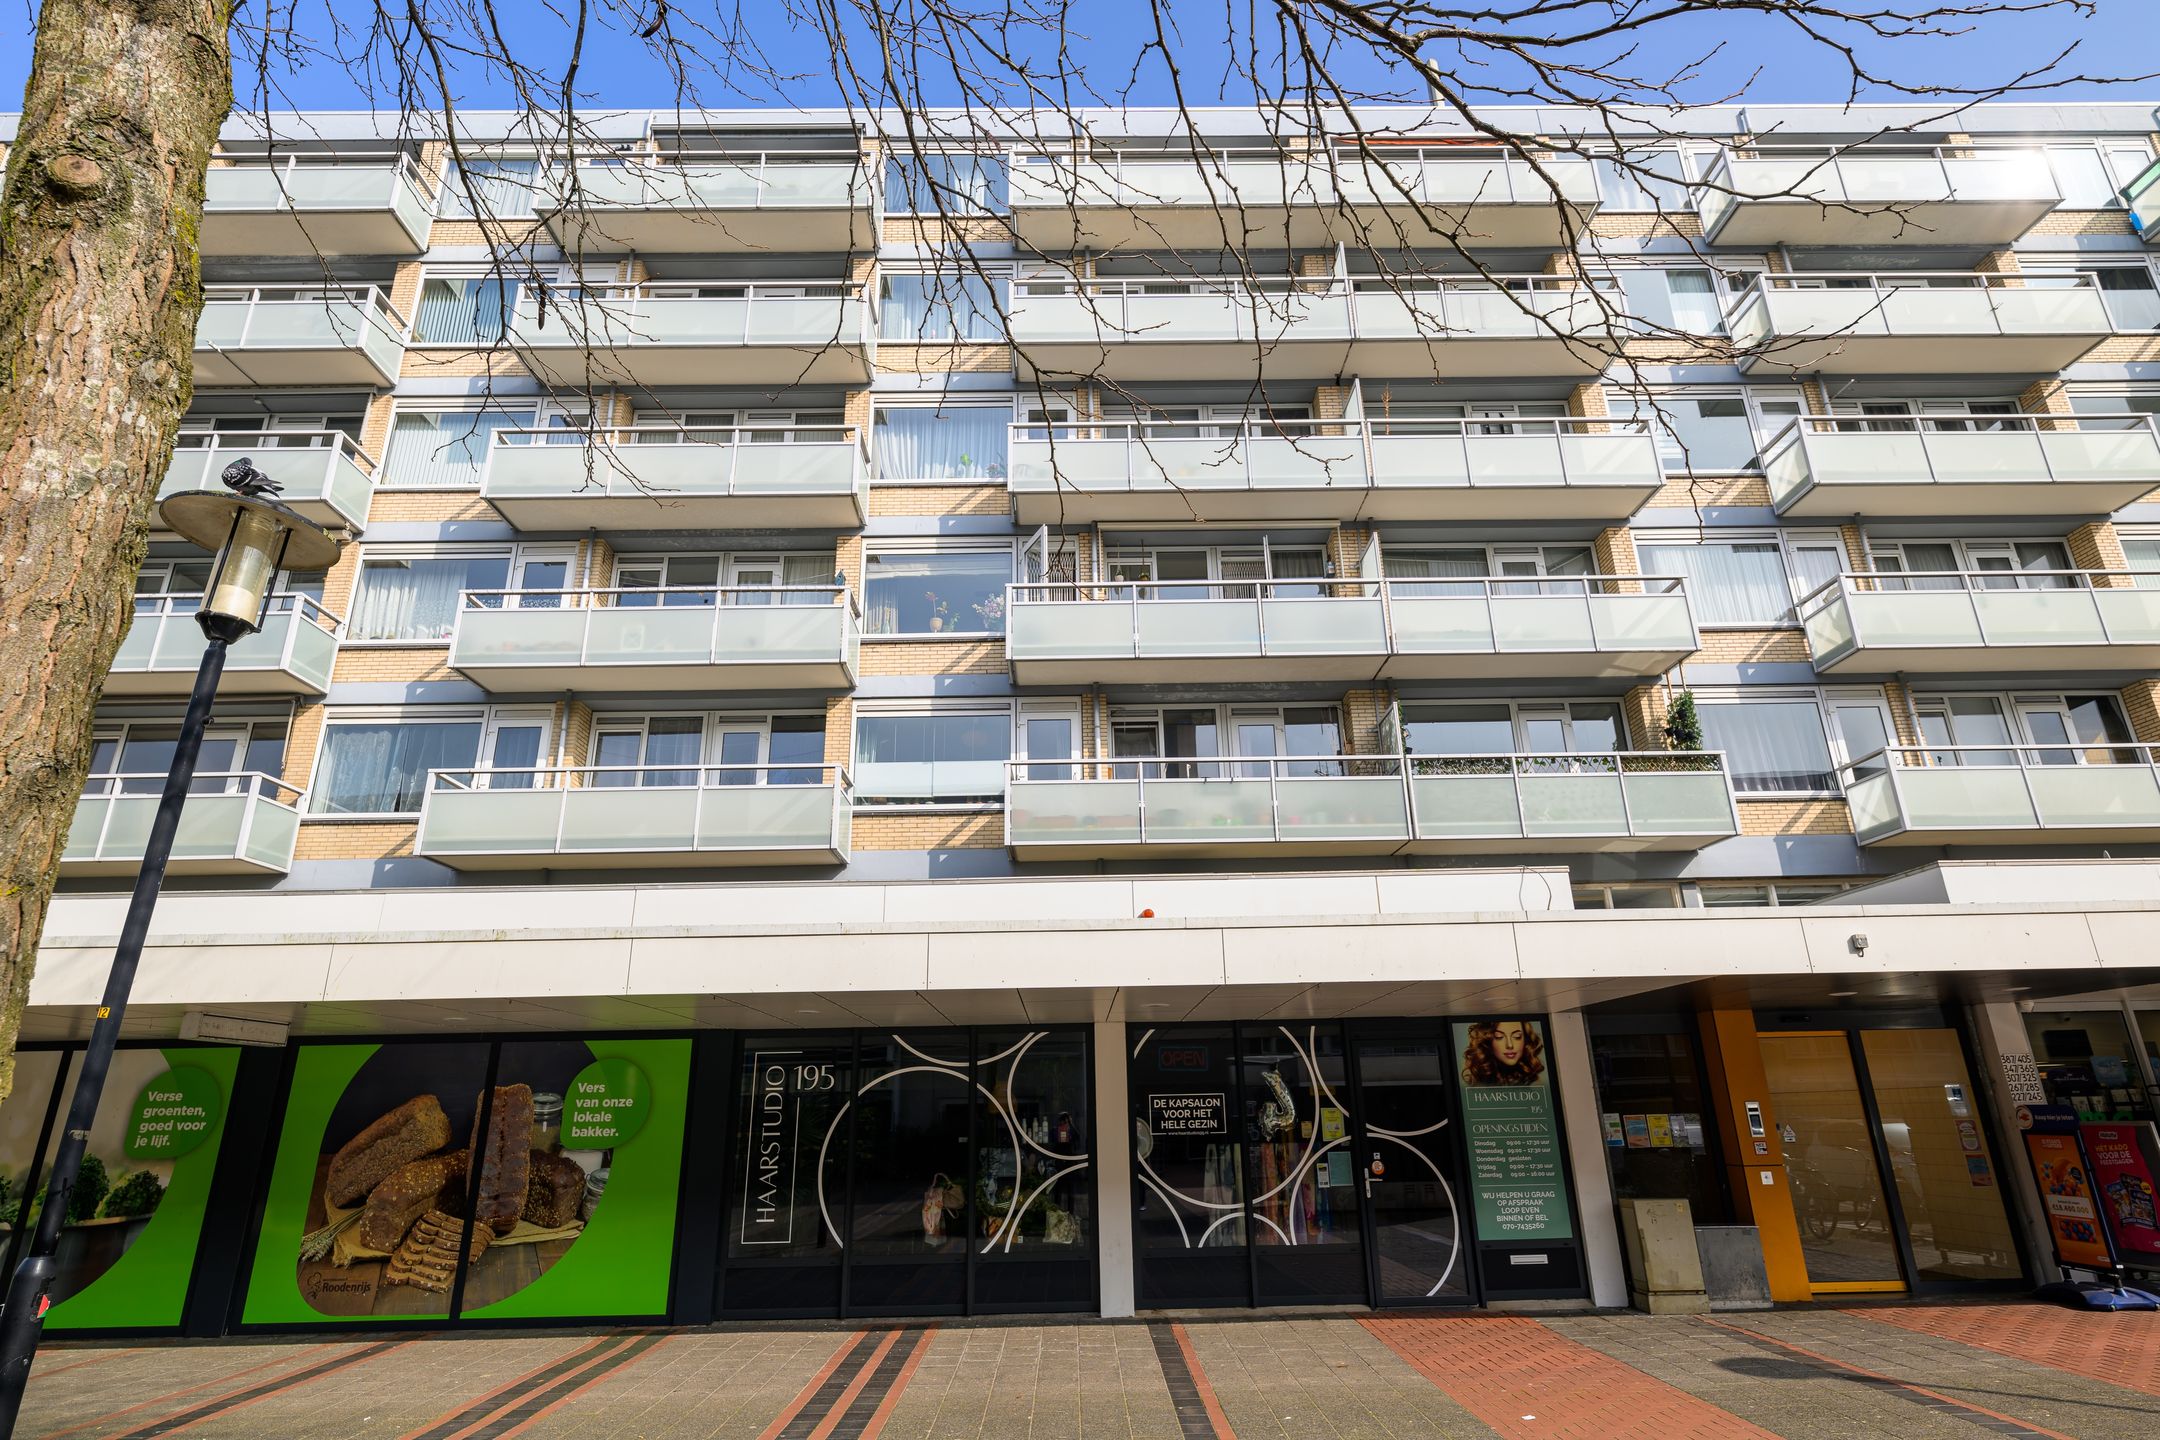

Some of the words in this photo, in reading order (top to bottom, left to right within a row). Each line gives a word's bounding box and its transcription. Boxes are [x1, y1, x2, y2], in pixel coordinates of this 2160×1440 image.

[1162, 1051, 1205, 1067] OPEN
[2003, 1065, 2035, 1073] 347/365
[793, 1065, 835, 1090] 195
[2006, 1073, 2037, 1082] 307/325
[578, 1082, 605, 1093] Vers
[2009, 1083, 2040, 1092] 267/285
[148, 1091, 183, 1101] Verse
[1474, 1091, 1540, 1102] HAARSTUDIO
[2012, 1092, 2042, 1101] 227/245
[576, 1099, 599, 1108] van
[602, 1098, 633, 1107] onze
[1153, 1099, 1167, 1108] DE
[1168, 1098, 1221, 1108] KAPSALON
[143, 1106, 206, 1118] groenten,
[1163, 1109, 1191, 1119] VOOR
[1193, 1108, 1212, 1118] HET
[1530, 1105, 1543, 1113] 195
[574, 1111, 612, 1123] lokale
[139, 1120, 173, 1133] goed
[176, 1121, 206, 1131] voor
[1161, 1120, 1186, 1130] HELE
[1187, 1119, 1218, 1129] GEZIN
[1472, 1122, 1548, 1134] OPENINGSTIJDEN
[571, 1126, 619, 1137] bakker.
[134, 1135, 148, 1148] je
[150, 1135, 170, 1148] lijf.
[755, 1065, 785, 1223] HAARSTUDIO
[2097, 1151, 2119, 1160] VOOR
[2120, 1150, 2132, 1158] DE
[1521, 1206, 1540, 1214] EVEN
[1502, 1222, 1545, 1230] 070-7435260
[322, 1280, 371, 1294] Roodenrijs
